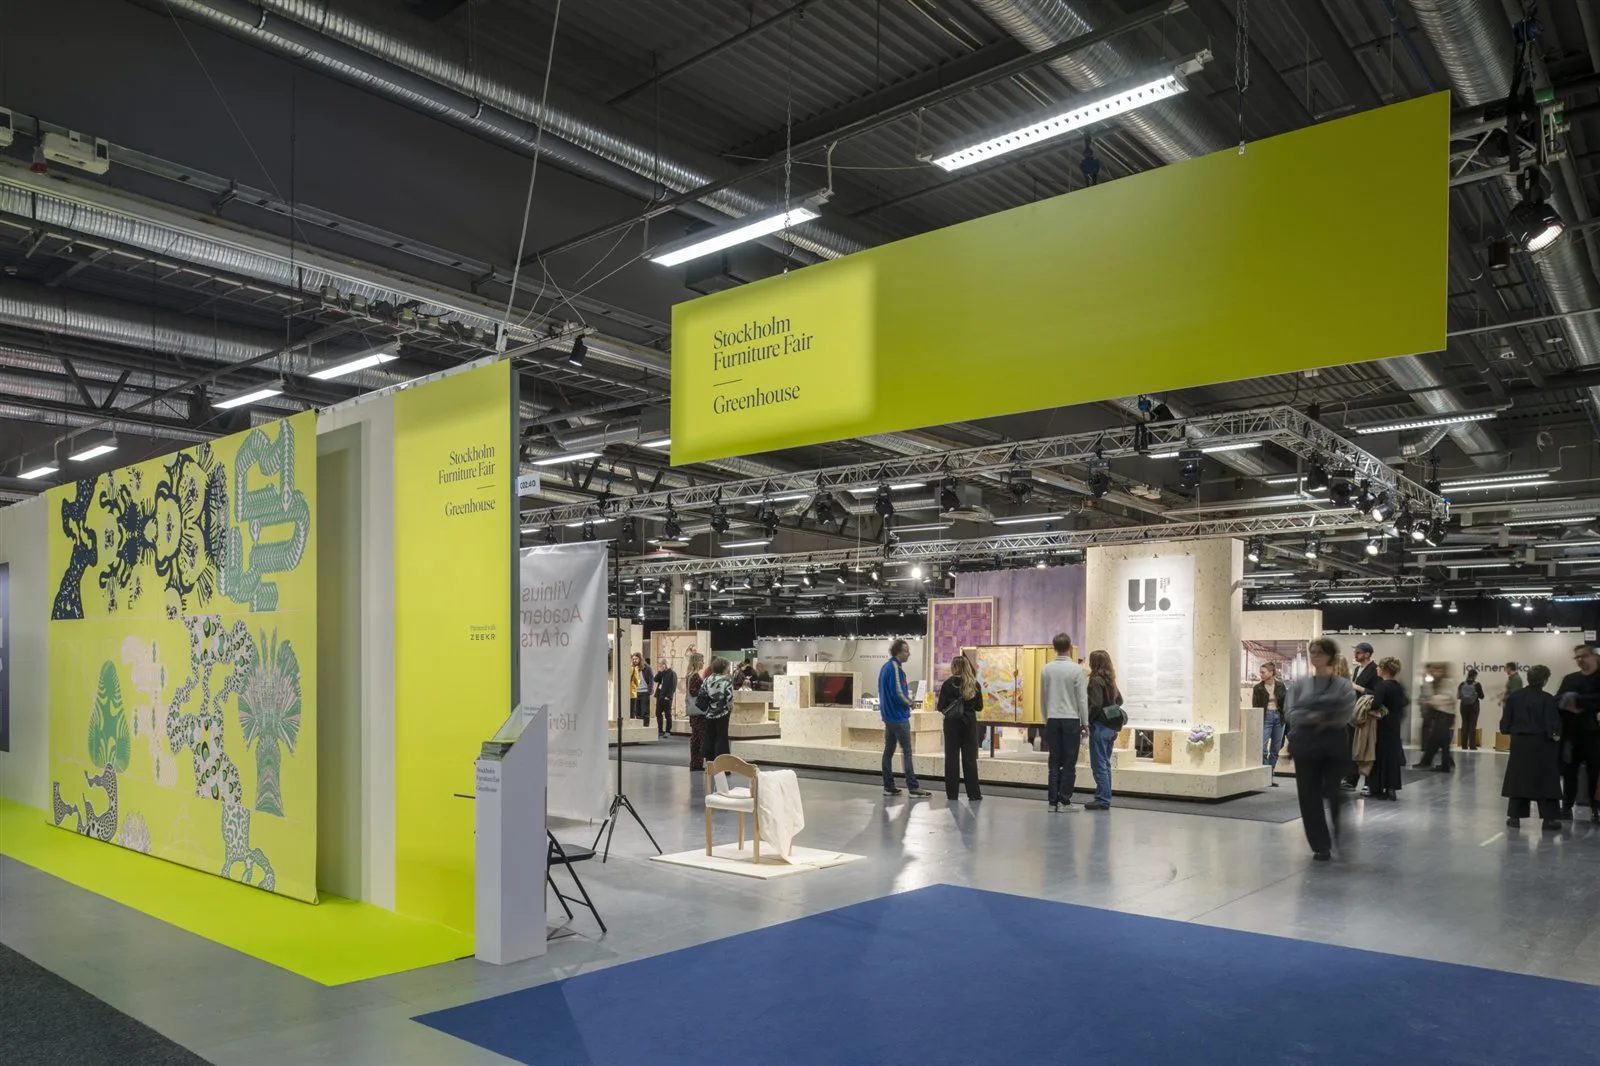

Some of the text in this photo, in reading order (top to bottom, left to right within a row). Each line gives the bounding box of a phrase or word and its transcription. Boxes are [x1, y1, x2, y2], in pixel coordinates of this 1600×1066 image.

[713, 316, 791, 349] Stockholm
[714, 333, 814, 371] Furniture Fair
[713, 385, 801, 415] Greenhouse
[449, 444, 495, 465] Stockholm
[438, 461, 496, 485] Furniture Fair
[445, 498, 496, 517] Greenhouse
[470, 633, 496, 641] ZEEKR
